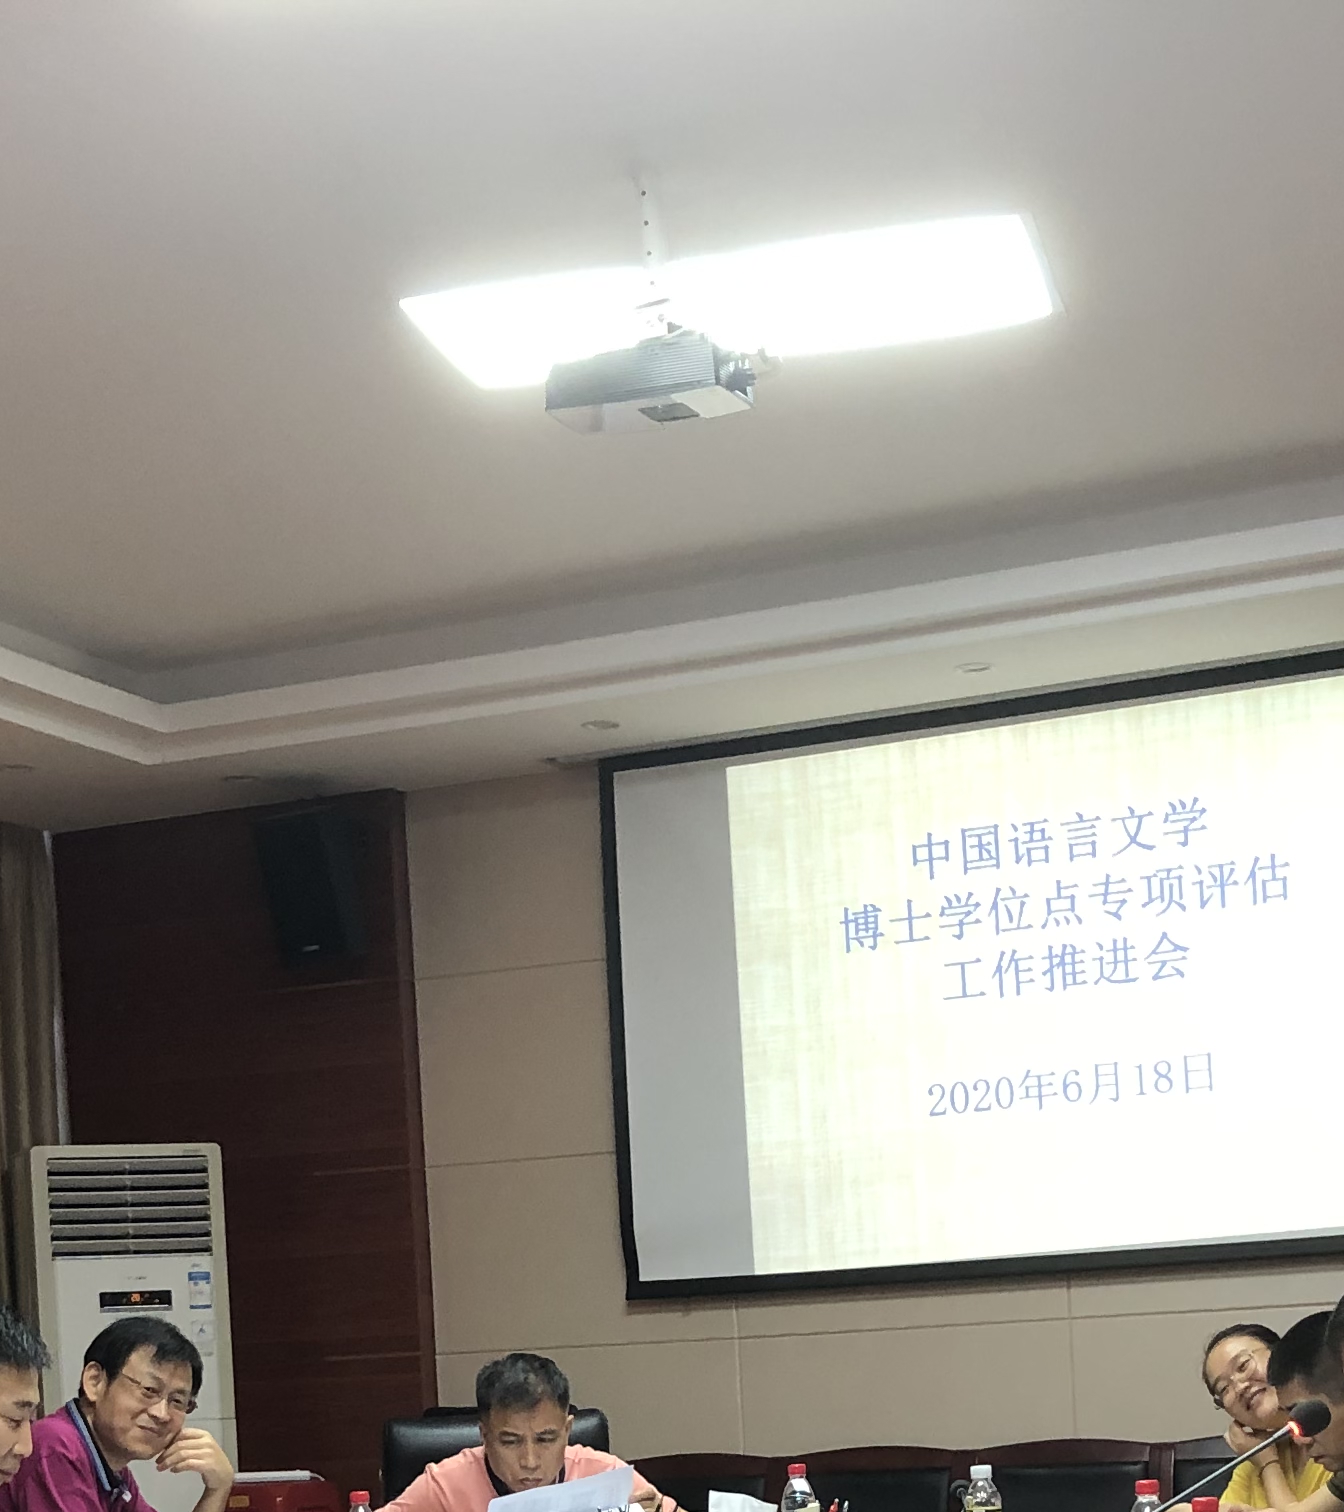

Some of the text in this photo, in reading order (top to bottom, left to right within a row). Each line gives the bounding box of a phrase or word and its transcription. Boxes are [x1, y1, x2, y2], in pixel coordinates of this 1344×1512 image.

[912, 797, 1209, 880] 中国语言文学
[838, 853, 1292, 953] 博士学位点专项评估
[941, 931, 1191, 1001] 工作推进会
[927, 1052, 1216, 1118] 2020年6月18日
